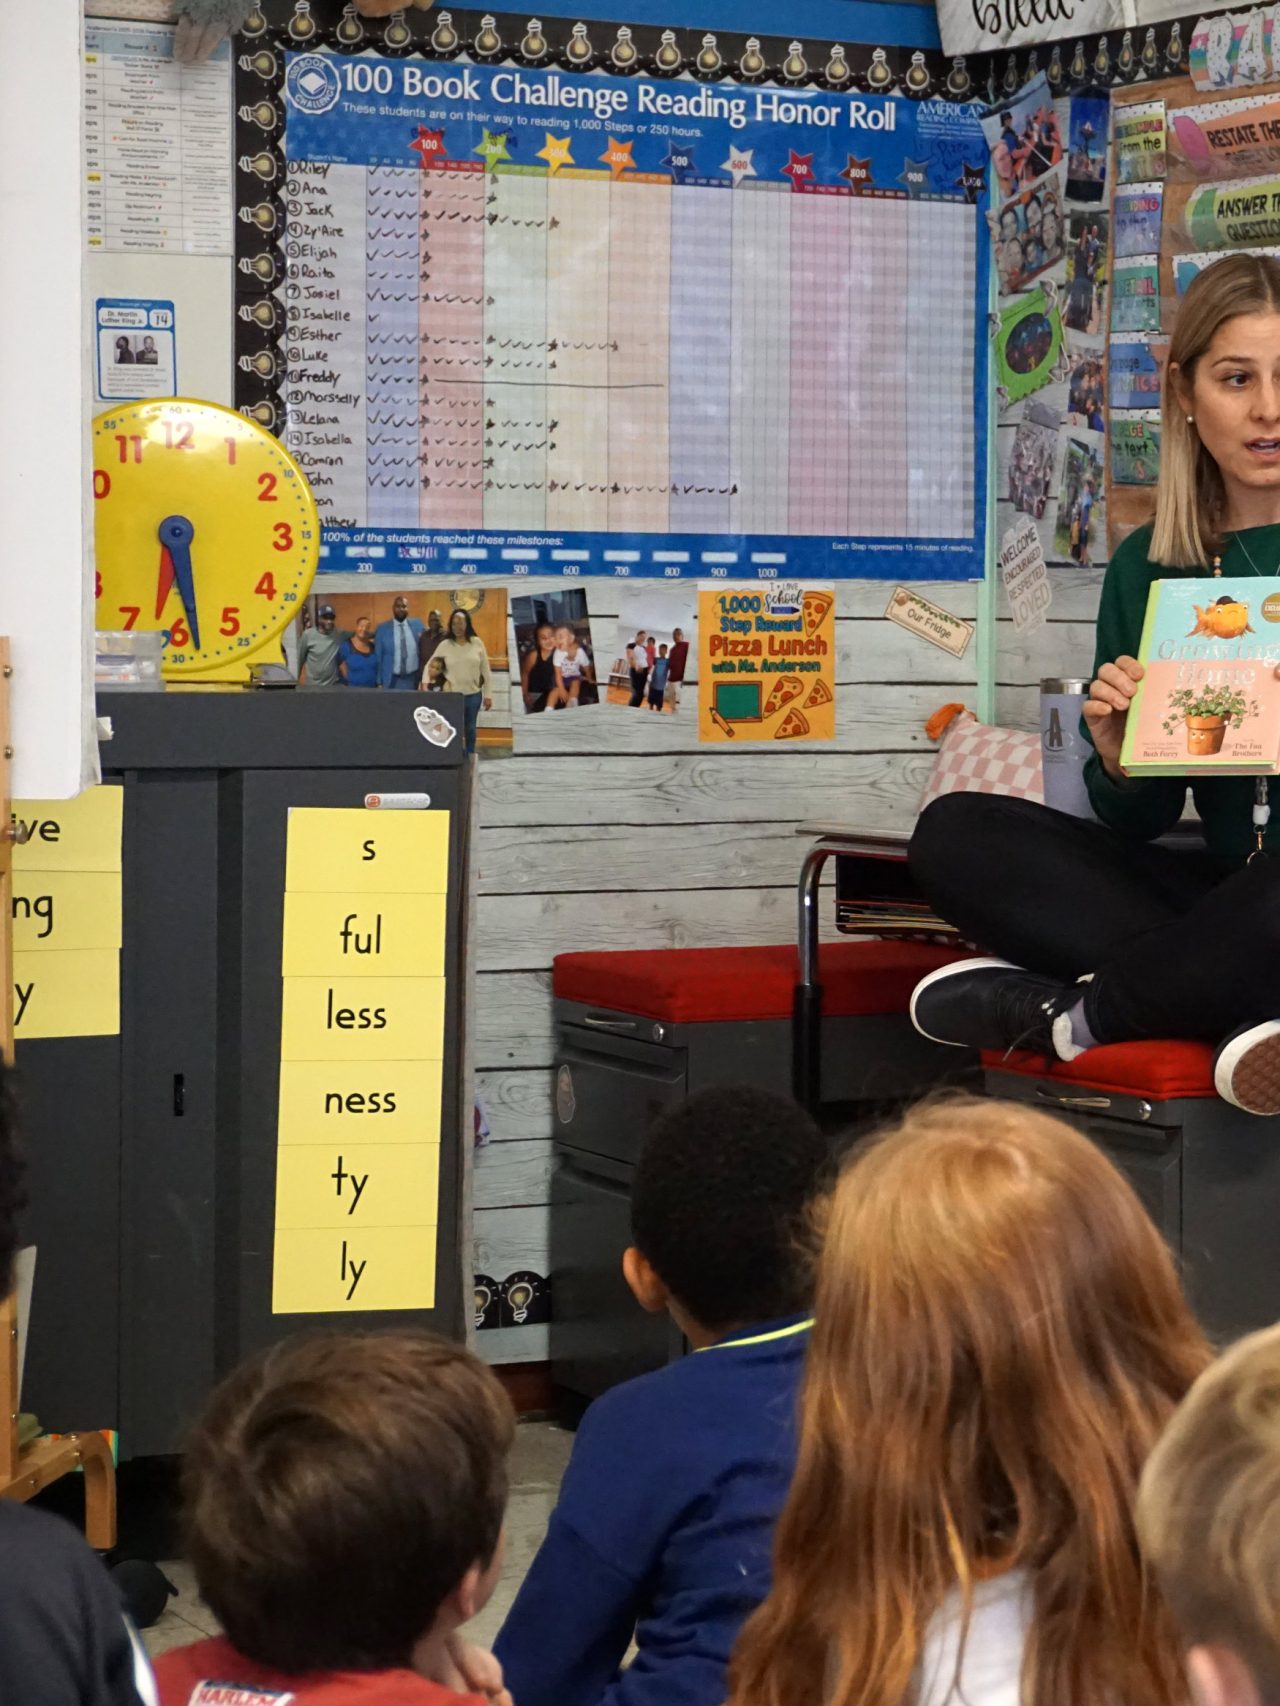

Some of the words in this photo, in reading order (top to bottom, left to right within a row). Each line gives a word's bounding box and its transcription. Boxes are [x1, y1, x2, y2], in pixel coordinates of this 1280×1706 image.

[342, 63, 392, 94] 100
[404, 67, 481, 100] Book
[491, 74, 628, 116] Challenge
[638, 84, 746, 128] Reading
[756, 99, 841, 127] Honor
[849, 101, 896, 131] Roll
[343, 102, 376, 116] These
[379, 105, 426, 118] students
[429, 109, 447, 120] are
[450, 111, 464, 120] on
[467, 111, 490, 122] their
[493, 115, 514, 127] way
[517, 115, 527, 125] to
[530, 117, 570, 131] reading
[574, 119, 601, 132] 1,000
[605, 120, 634, 135] Steps
[637, 126, 647, 134] or
[650, 124, 668, 136] 250
[421, 139, 438, 151] 100
[1206, 124, 1260, 149] RESTATE
[301, 162, 330, 179] Riley
[671, 155, 688, 167] 500
[731, 159, 748, 171] 600
[791, 163, 808, 175] 700
[850, 168, 866, 179] 800
[302, 182, 328, 196] Ana
[304, 202, 334, 218] Jack
[1216, 194, 1268, 219] ANSWER
[301, 245, 337, 261] Elijah
[301, 267, 336, 279] Raita
[302, 308, 351, 322] Isabelle
[300, 325, 342, 342] Esther
[302, 349, 329, 362] Luke
[300, 368, 340, 388] Freddy
[162, 420, 195, 450] 12
[304, 432, 352, 445] Isabella
[115, 435, 143, 464] 11
[224, 436, 237, 466] 1
[257, 472, 278, 502] 2
[272, 522, 294, 552] 3
[322, 532, 350, 542] 100%
[354, 533, 365, 543] of
[367, 533, 384, 543] the
[386, 534, 430, 544] students
[433, 534, 474, 545] reached
[476, 535, 504, 545] these
[506, 536, 563, 546] milestones:
[1001, 526, 1038, 566] WELCOME
[461, 564, 476, 574] 400
[513, 564, 528, 575] 500
[563, 566, 579, 576] 600
[614, 566, 629, 577] 700
[664, 567, 680, 577] 800
[711, 567, 727, 578] 900
[1005, 546, 1041, 585] ENCOURAGED
[254, 571, 277, 601] 4
[1008, 563, 1045, 601] RESPECTED
[720, 595, 761, 616] 1,000
[1013, 582, 1050, 627] LOVED
[119, 606, 141, 632] 7
[219, 606, 241, 637] 5
[169, 618, 189, 648] 6
[720, 616, 751, 635] Step
[755, 616, 802, 632] Reward
[907, 608, 925, 623] Our
[924, 616, 952, 640] Fridge
[709, 635, 762, 656] Pizza
[768, 636, 827, 656] Lunch
[711, 660, 736, 673] with
[738, 659, 757, 673] Ms.
[760, 659, 821, 673] Anderson
[361, 838, 377, 861] s
[339, 913, 382, 954] ful
[327, 988, 388, 1029] less
[324, 1091, 397, 1114] ness
[331, 1155, 369, 1215] ty
[341, 1241, 367, 1301] ly
